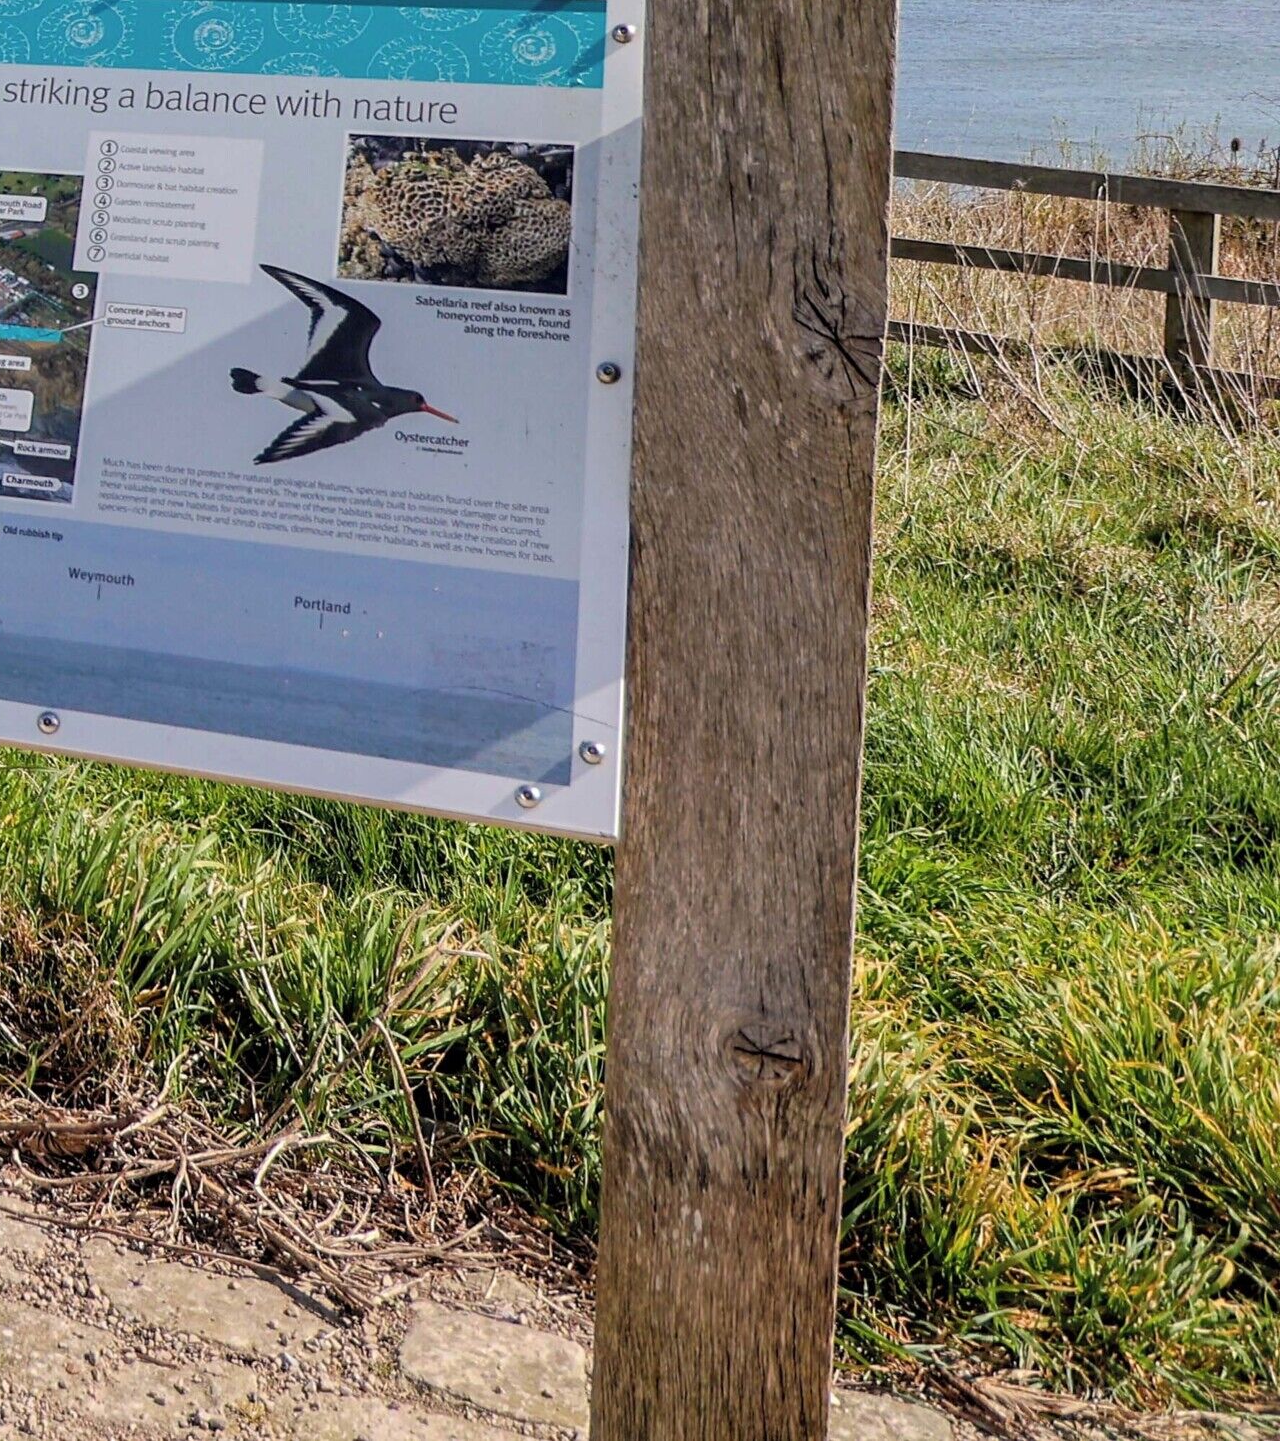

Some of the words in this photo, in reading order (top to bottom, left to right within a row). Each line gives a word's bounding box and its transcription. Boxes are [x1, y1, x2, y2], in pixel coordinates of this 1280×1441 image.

[3, 78, 111, 113] striking
[118, 90, 134, 108] a
[146, 83, 265, 115] balance
[276, 89, 341, 118] with
[353, 95, 458, 124] nature
[121, 145, 148, 155] Coastal
[150, 147, 177, 157] viewing
[119, 162, 140, 171] Active
[143, 164, 176, 173] landslide
[178, 166, 204, 175] habitat
[117, 180, 155, 190] Dormouse
[164, 183, 177, 191] bat
[179, 184, 205, 193] habitat
[207, 186, 238, 194] creation
[8, 207, 24, 216] Park
[23, 199, 42, 210] Road
[112, 215, 151, 225] Woodland
[153, 218, 173, 227] scrub
[175, 219, 206, 230] planting
[110, 233, 147, 244] Grassland
[149, 236, 164, 244] and
[166, 237, 186, 246] scrub
[188, 238, 219, 250] planting
[108, 305, 143, 316] Concrete
[146, 307, 165, 318] piles
[167, 309, 183, 318] and
[416, 296, 468, 309] Sabellaria
[471, 301, 492, 311] reef
[494, 303, 516, 313] also
[519, 304, 555, 315] known
[107, 317, 136, 327] ground
[137, 318, 170, 329] anchors
[437, 310, 499, 323] honeycomb
[502, 317, 536, 327] worm,
[538, 318, 570, 329] found
[464, 325, 494, 337] along
[497, 327, 514, 337] the
[517, 329, 569, 341] foreshore
[8, 358, 25, 367] area
[395, 431, 469, 447] Oystercatcher
[17, 443, 38, 453] Rock
[40, 446, 67, 456] armour
[6, 475, 53, 488] Charmouth
[3, 526, 17, 536] Old
[19, 527, 49, 540] rubbish
[51, 531, 63, 542] tip
[69, 567, 135, 587] Weymouth
[294, 596, 351, 615] Portland
